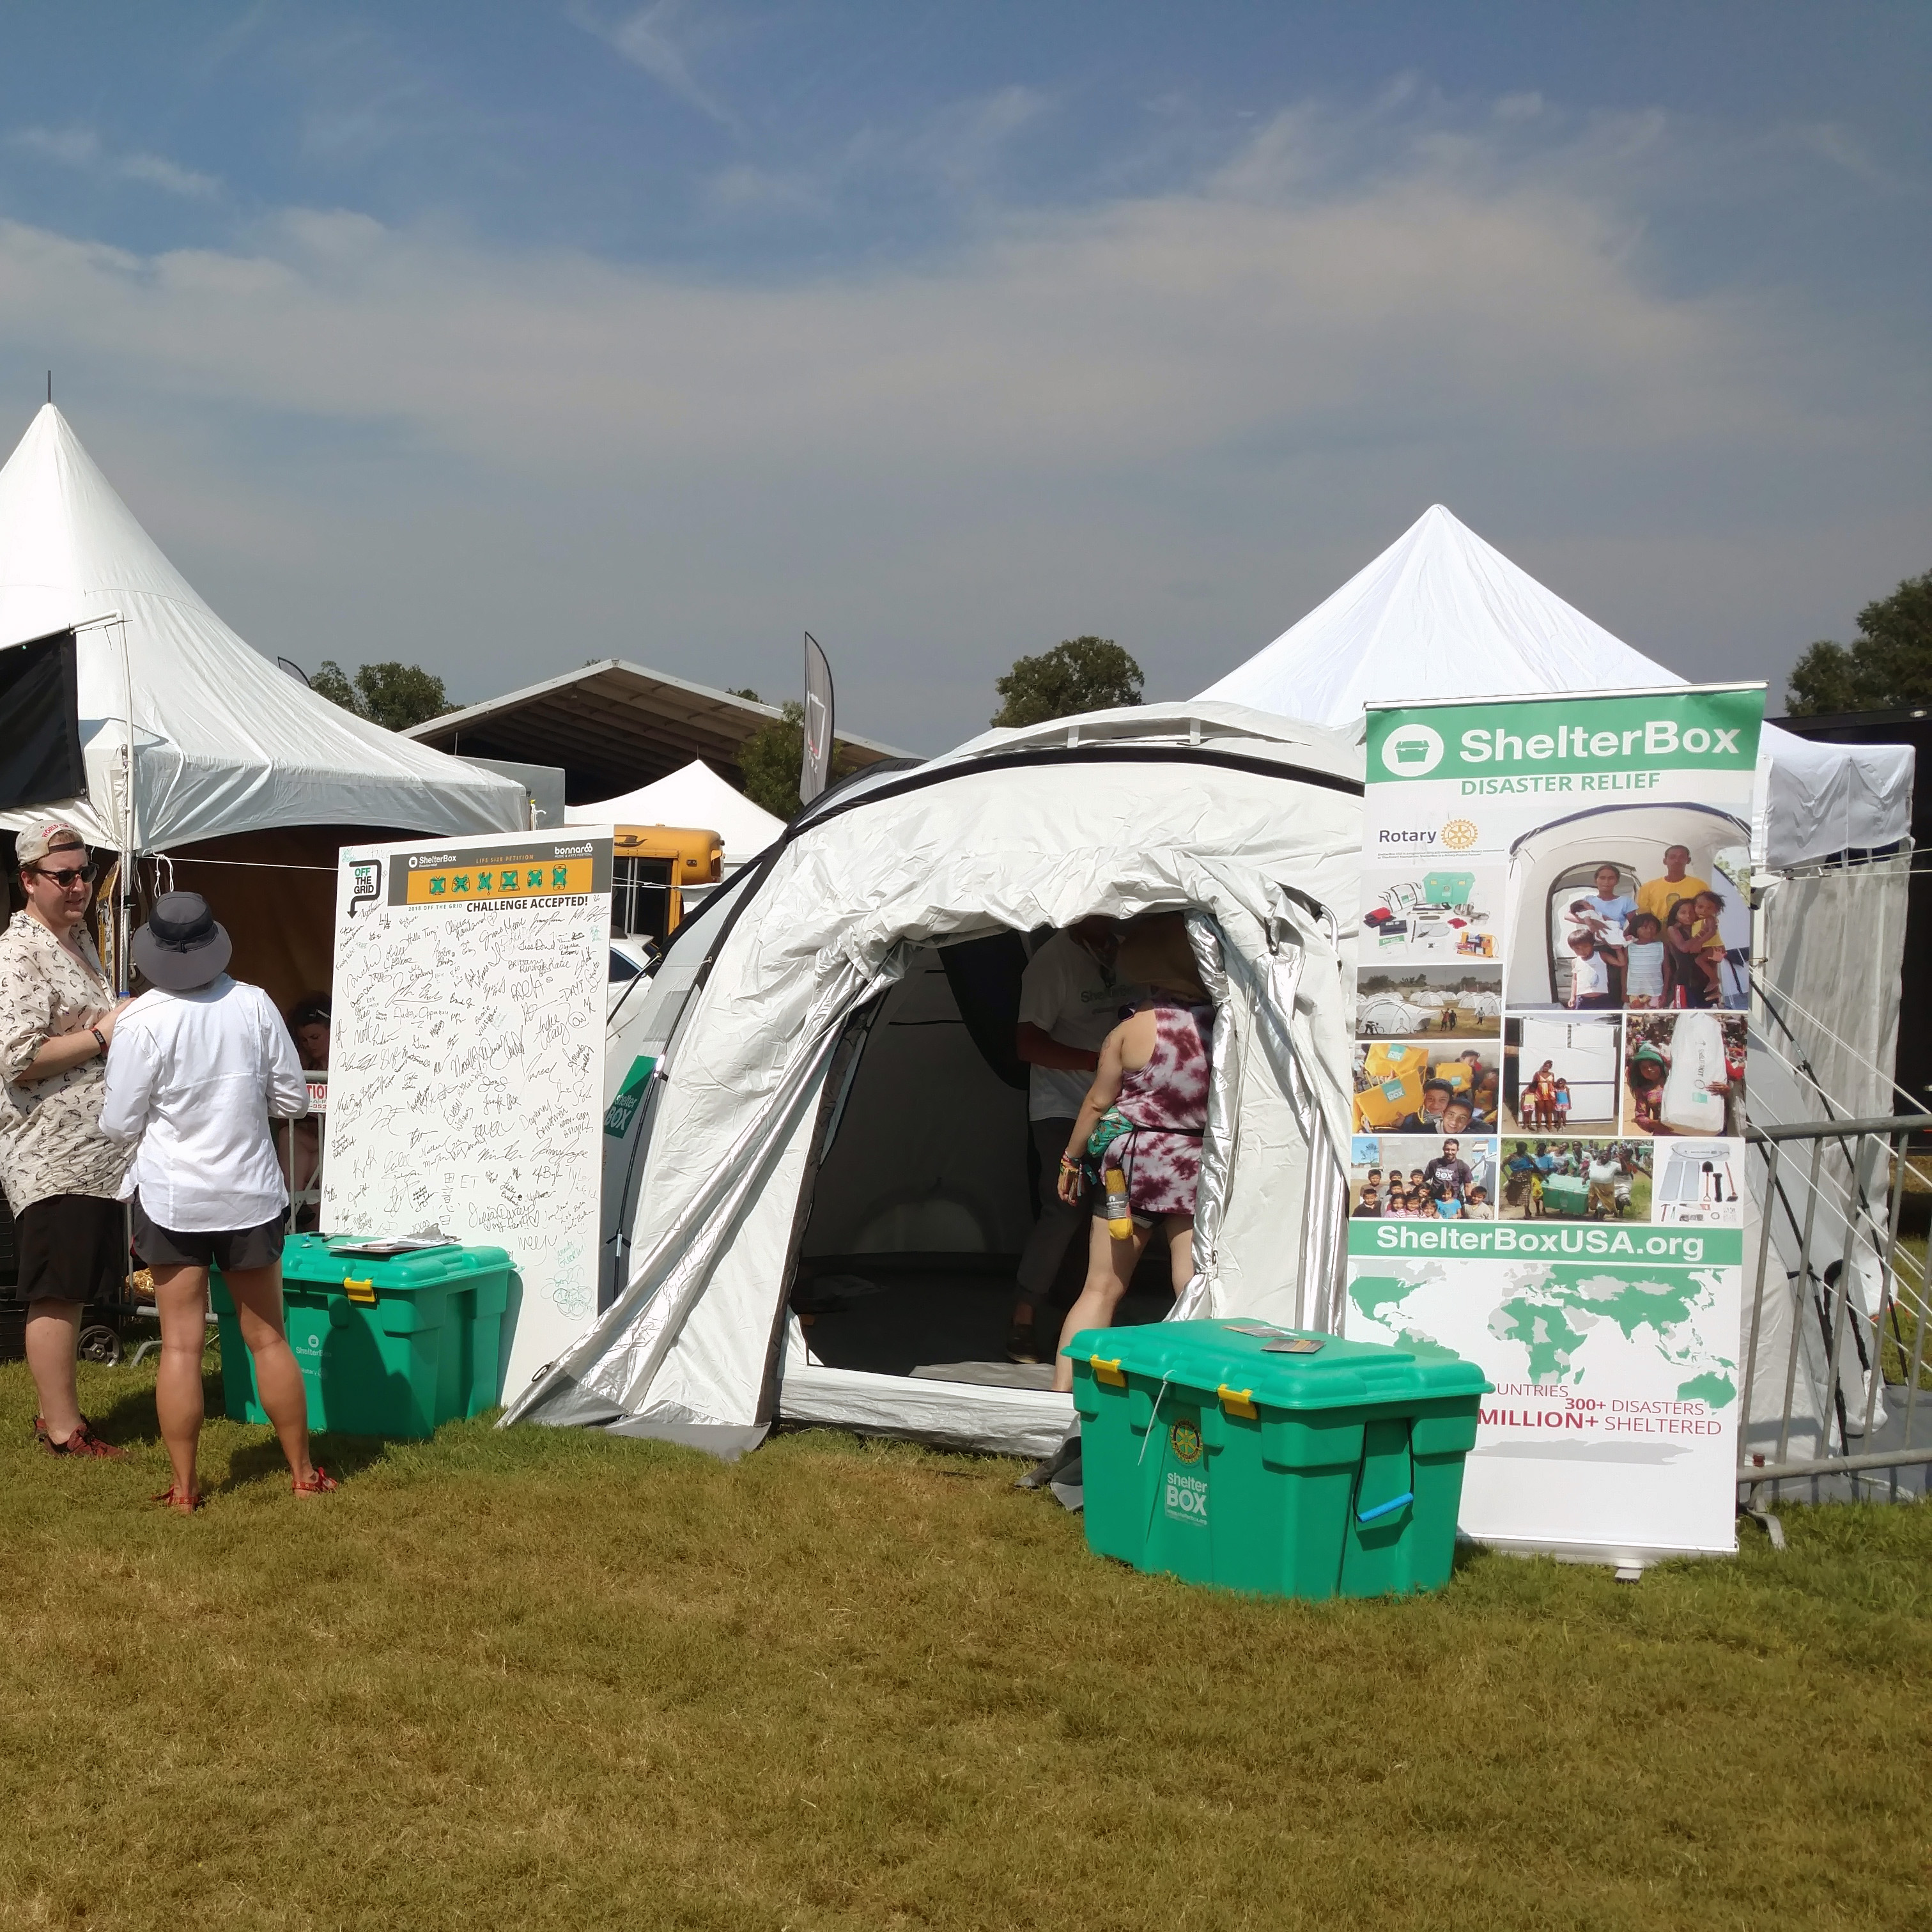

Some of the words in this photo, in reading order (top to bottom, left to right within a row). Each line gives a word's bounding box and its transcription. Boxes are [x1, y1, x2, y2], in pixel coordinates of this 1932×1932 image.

[1460, 720, 1741, 763] ShelterBox
[1460, 775, 1573, 796] DISASTER
[1580, 772, 1660, 791] RELIEF
[42, 824, 59, 838] WORLD
[1379, 830, 1437, 844] Rotary
[419, 854, 456, 864] ShelterBox
[505, 854, 534, 862] PETITION
[354, 867, 371, 877] OFF
[355, 876, 371, 886] THE
[353, 885, 374, 895] GRID
[467, 899, 527, 913] CHALLENGE
[530, 895, 588, 909] ACCEPTED!
[615, 1093, 638, 1108] shelter
[604, 1106, 632, 1131] BOX
[1435, 1171, 1453, 1180] BOX
[1377, 1225, 1704, 1262] ShelterBoxUSA.org
[1497, 1383, 1568, 1398] UNTRIES
[1564, 1398, 1606, 1412] 300+
[1611, 1399, 1704, 1416] DISASTERS
[1478, 1408, 1598, 1430] MILLION+
[1604, 1415, 1722, 1435] SHELTERED
[1167, 1472, 1208, 1493] shelter
[1166, 1483, 1207, 1517] BOX
